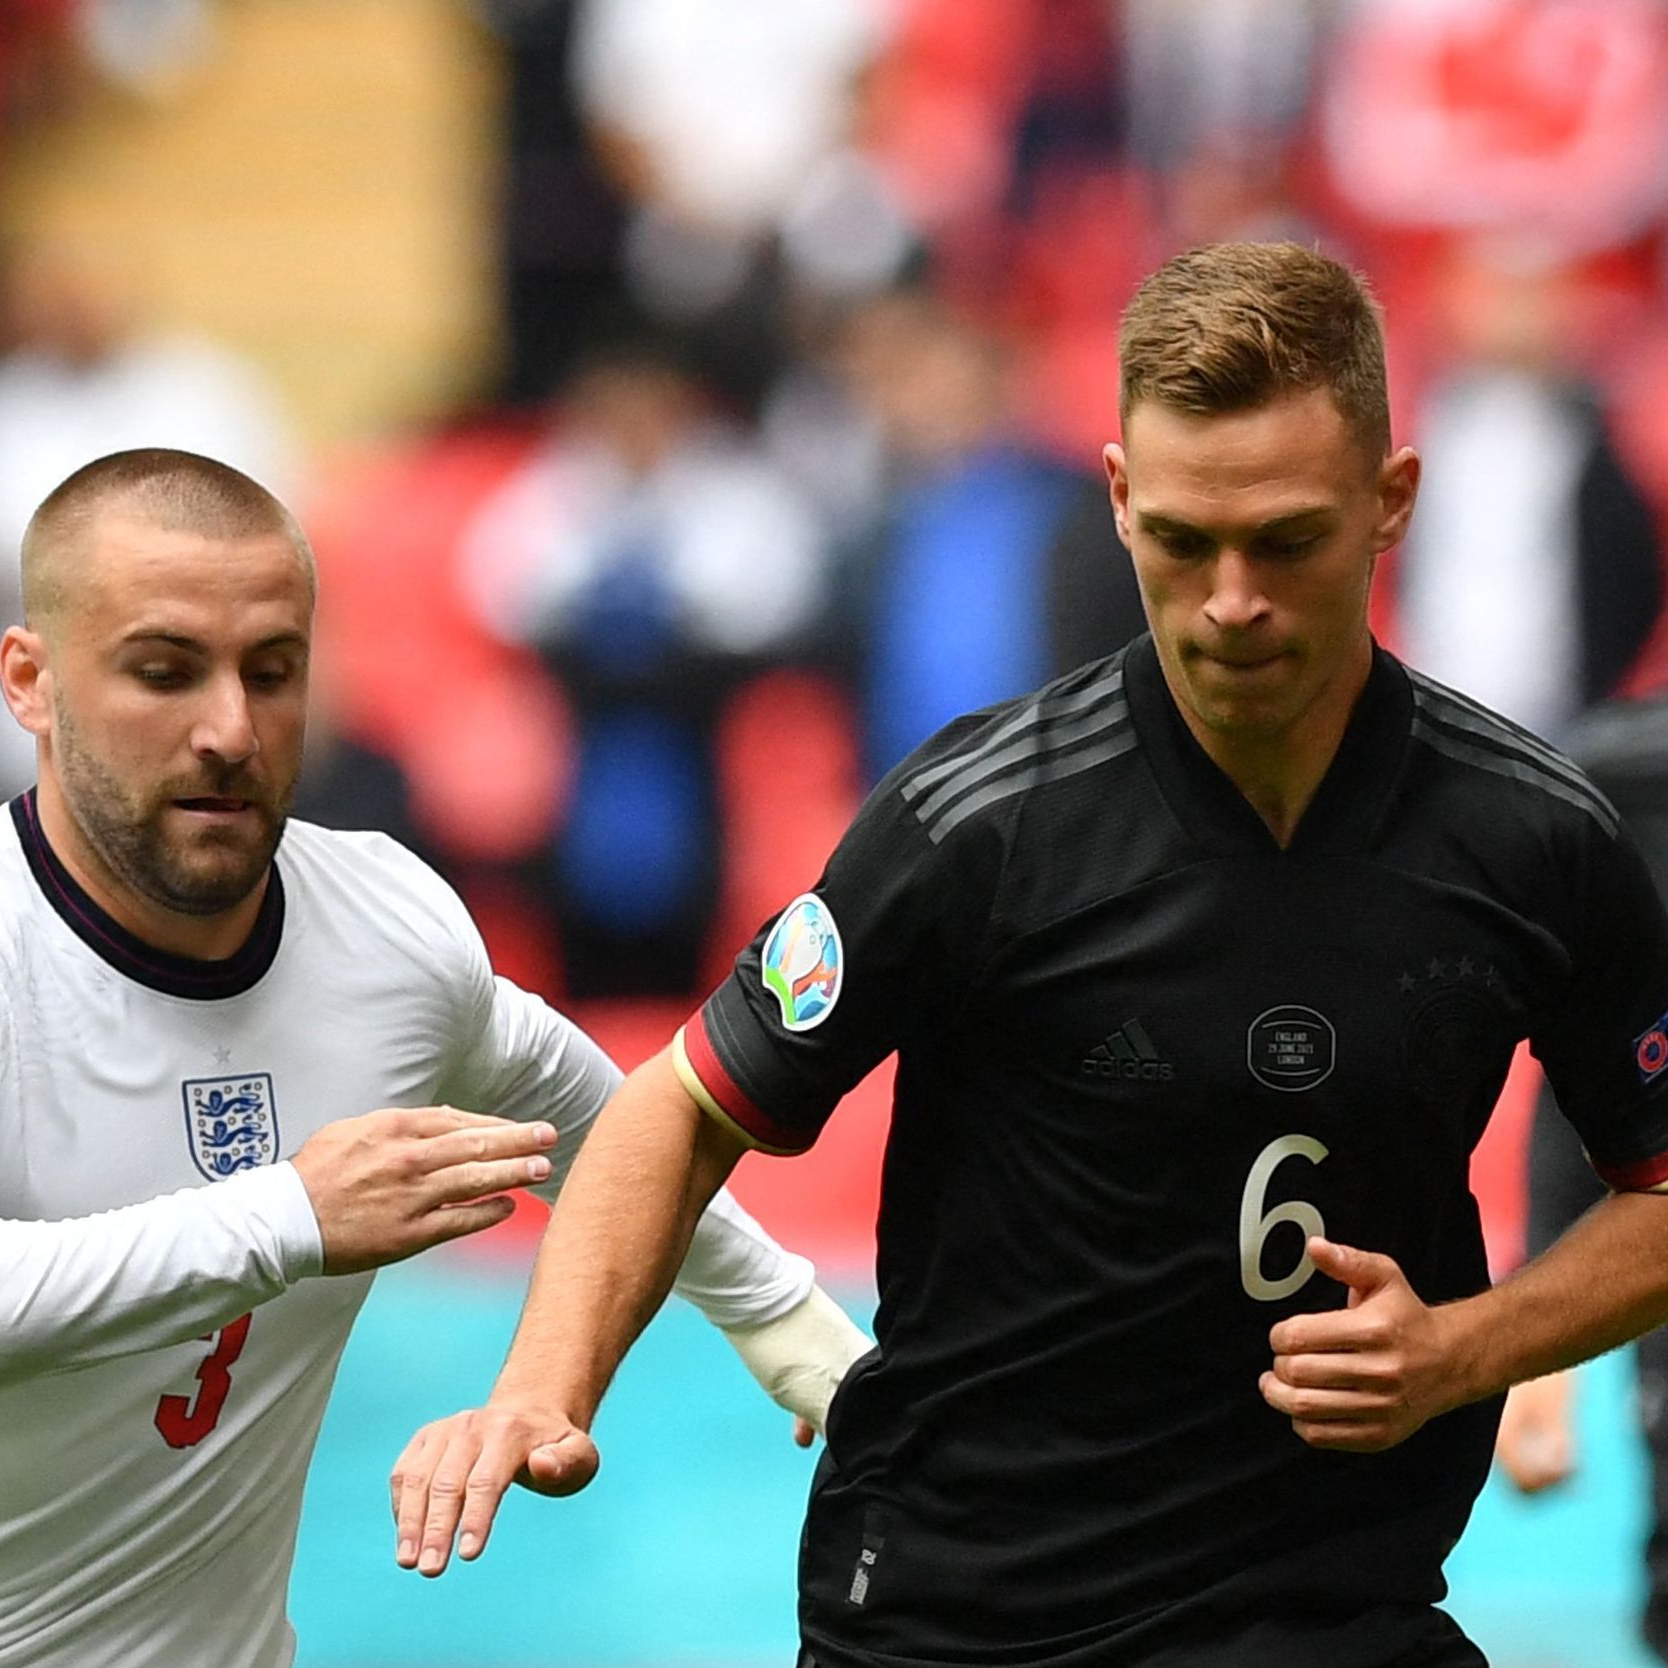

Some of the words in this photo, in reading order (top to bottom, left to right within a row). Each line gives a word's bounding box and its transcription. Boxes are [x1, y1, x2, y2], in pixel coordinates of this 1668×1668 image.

[1082, 1055, 1175, 1081] adidas
[1239, 1133, 1329, 1301] 6
[154, 1311, 252, 1450] 3
